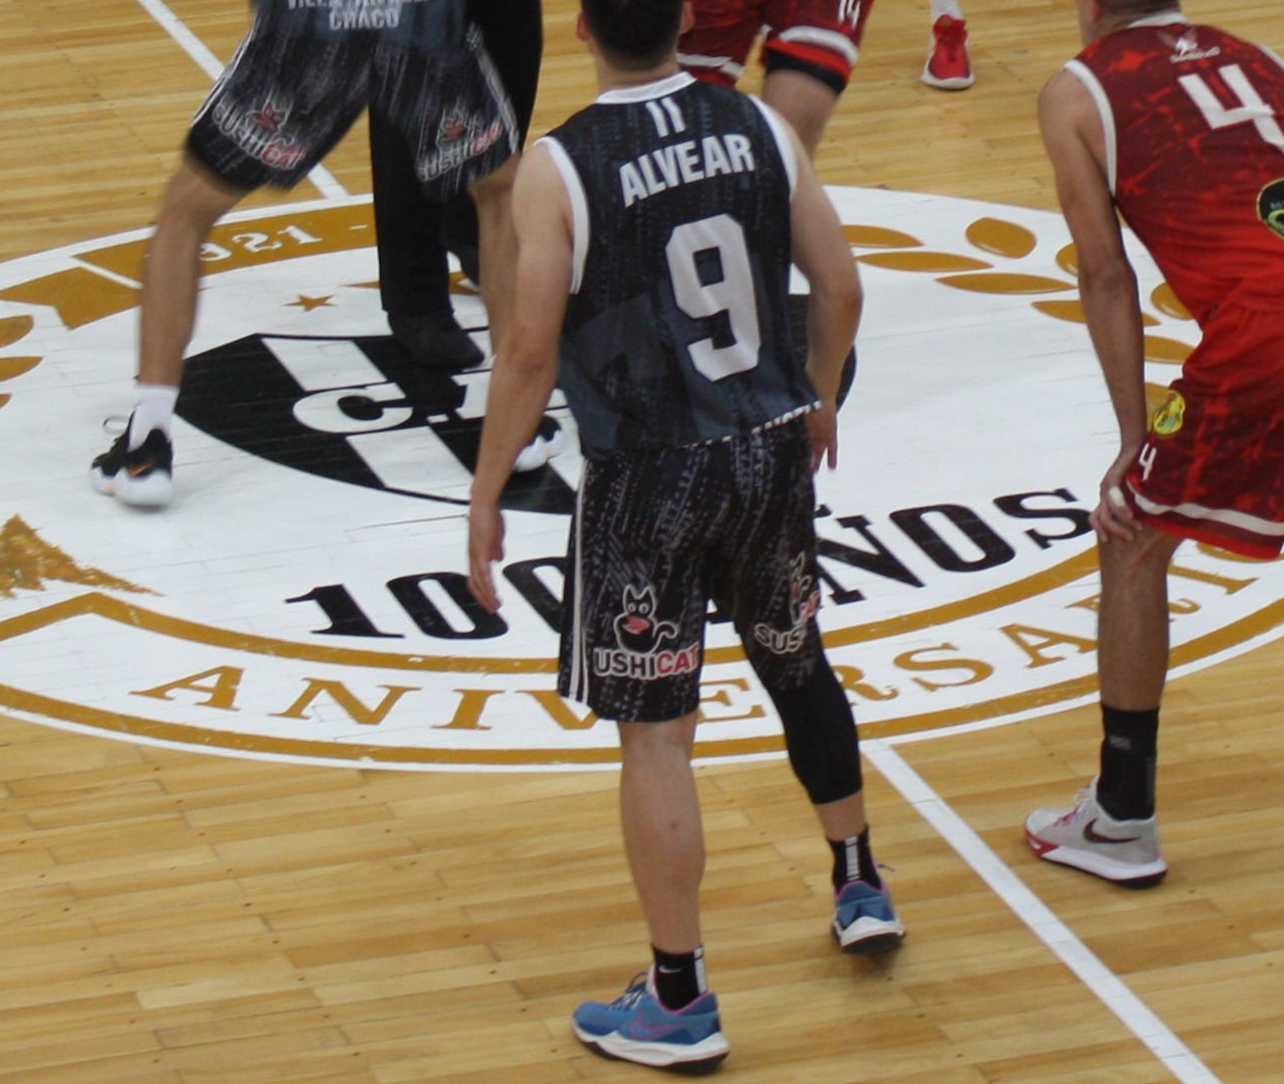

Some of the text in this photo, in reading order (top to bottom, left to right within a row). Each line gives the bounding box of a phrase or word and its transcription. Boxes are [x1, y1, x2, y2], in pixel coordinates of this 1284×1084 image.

[328, 3, 402, 31] CHACO
[619, 133, 756, 209] ALVEAR
[666, 214, 762, 382] 9
[1138, 442, 1157, 482] 4
[593, 642, 701, 681] USHICAT
